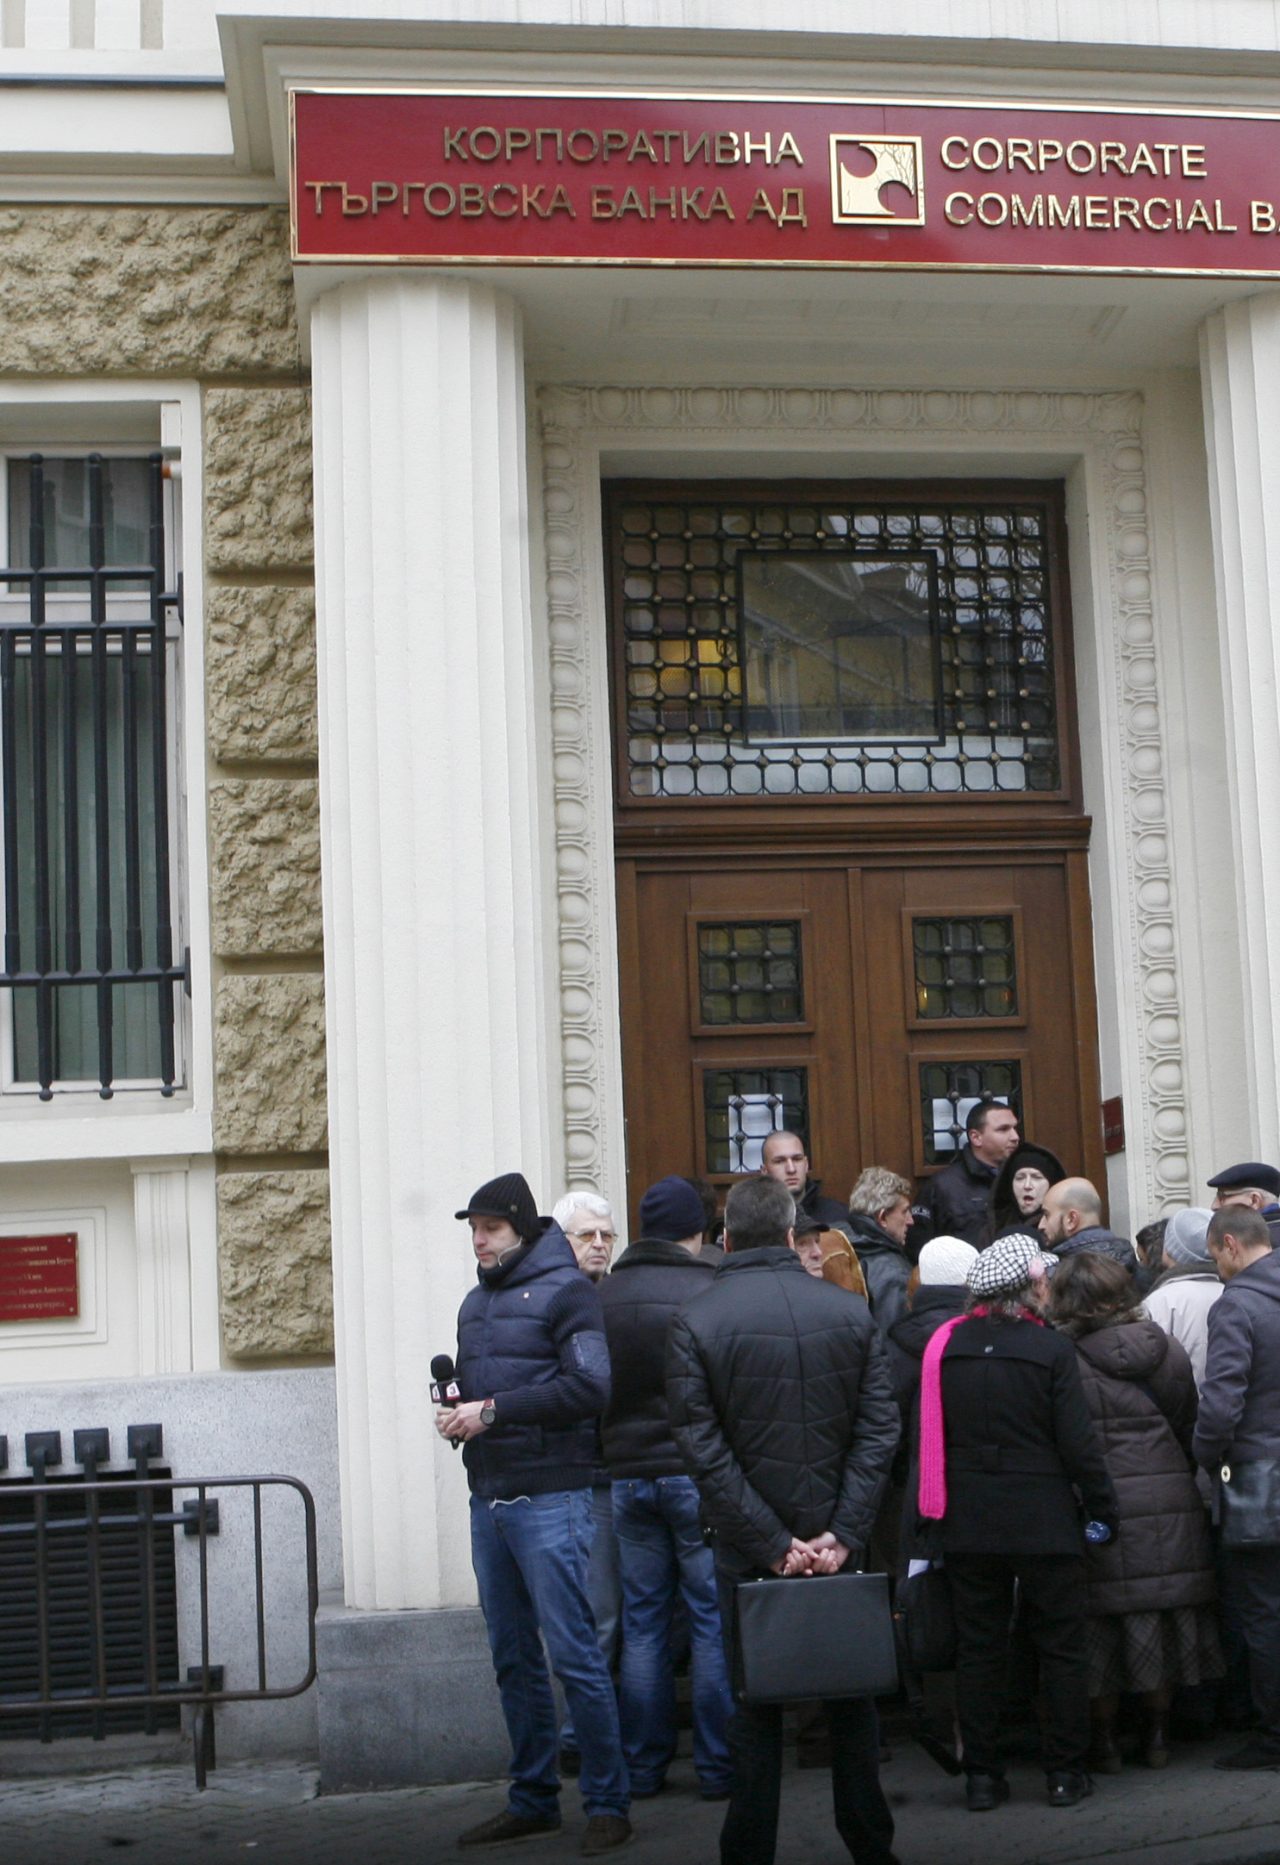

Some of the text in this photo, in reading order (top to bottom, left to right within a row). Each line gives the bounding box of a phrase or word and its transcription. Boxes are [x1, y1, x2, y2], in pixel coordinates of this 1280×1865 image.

[443, 126, 803, 166] КОРПОРАТИВНА
[940, 136, 1207, 178] CORPORATE
[304, 180, 808, 228] ТЪРГОВСКА БАНКА АД
[944, 192, 1237, 233] COMMERCIAL
